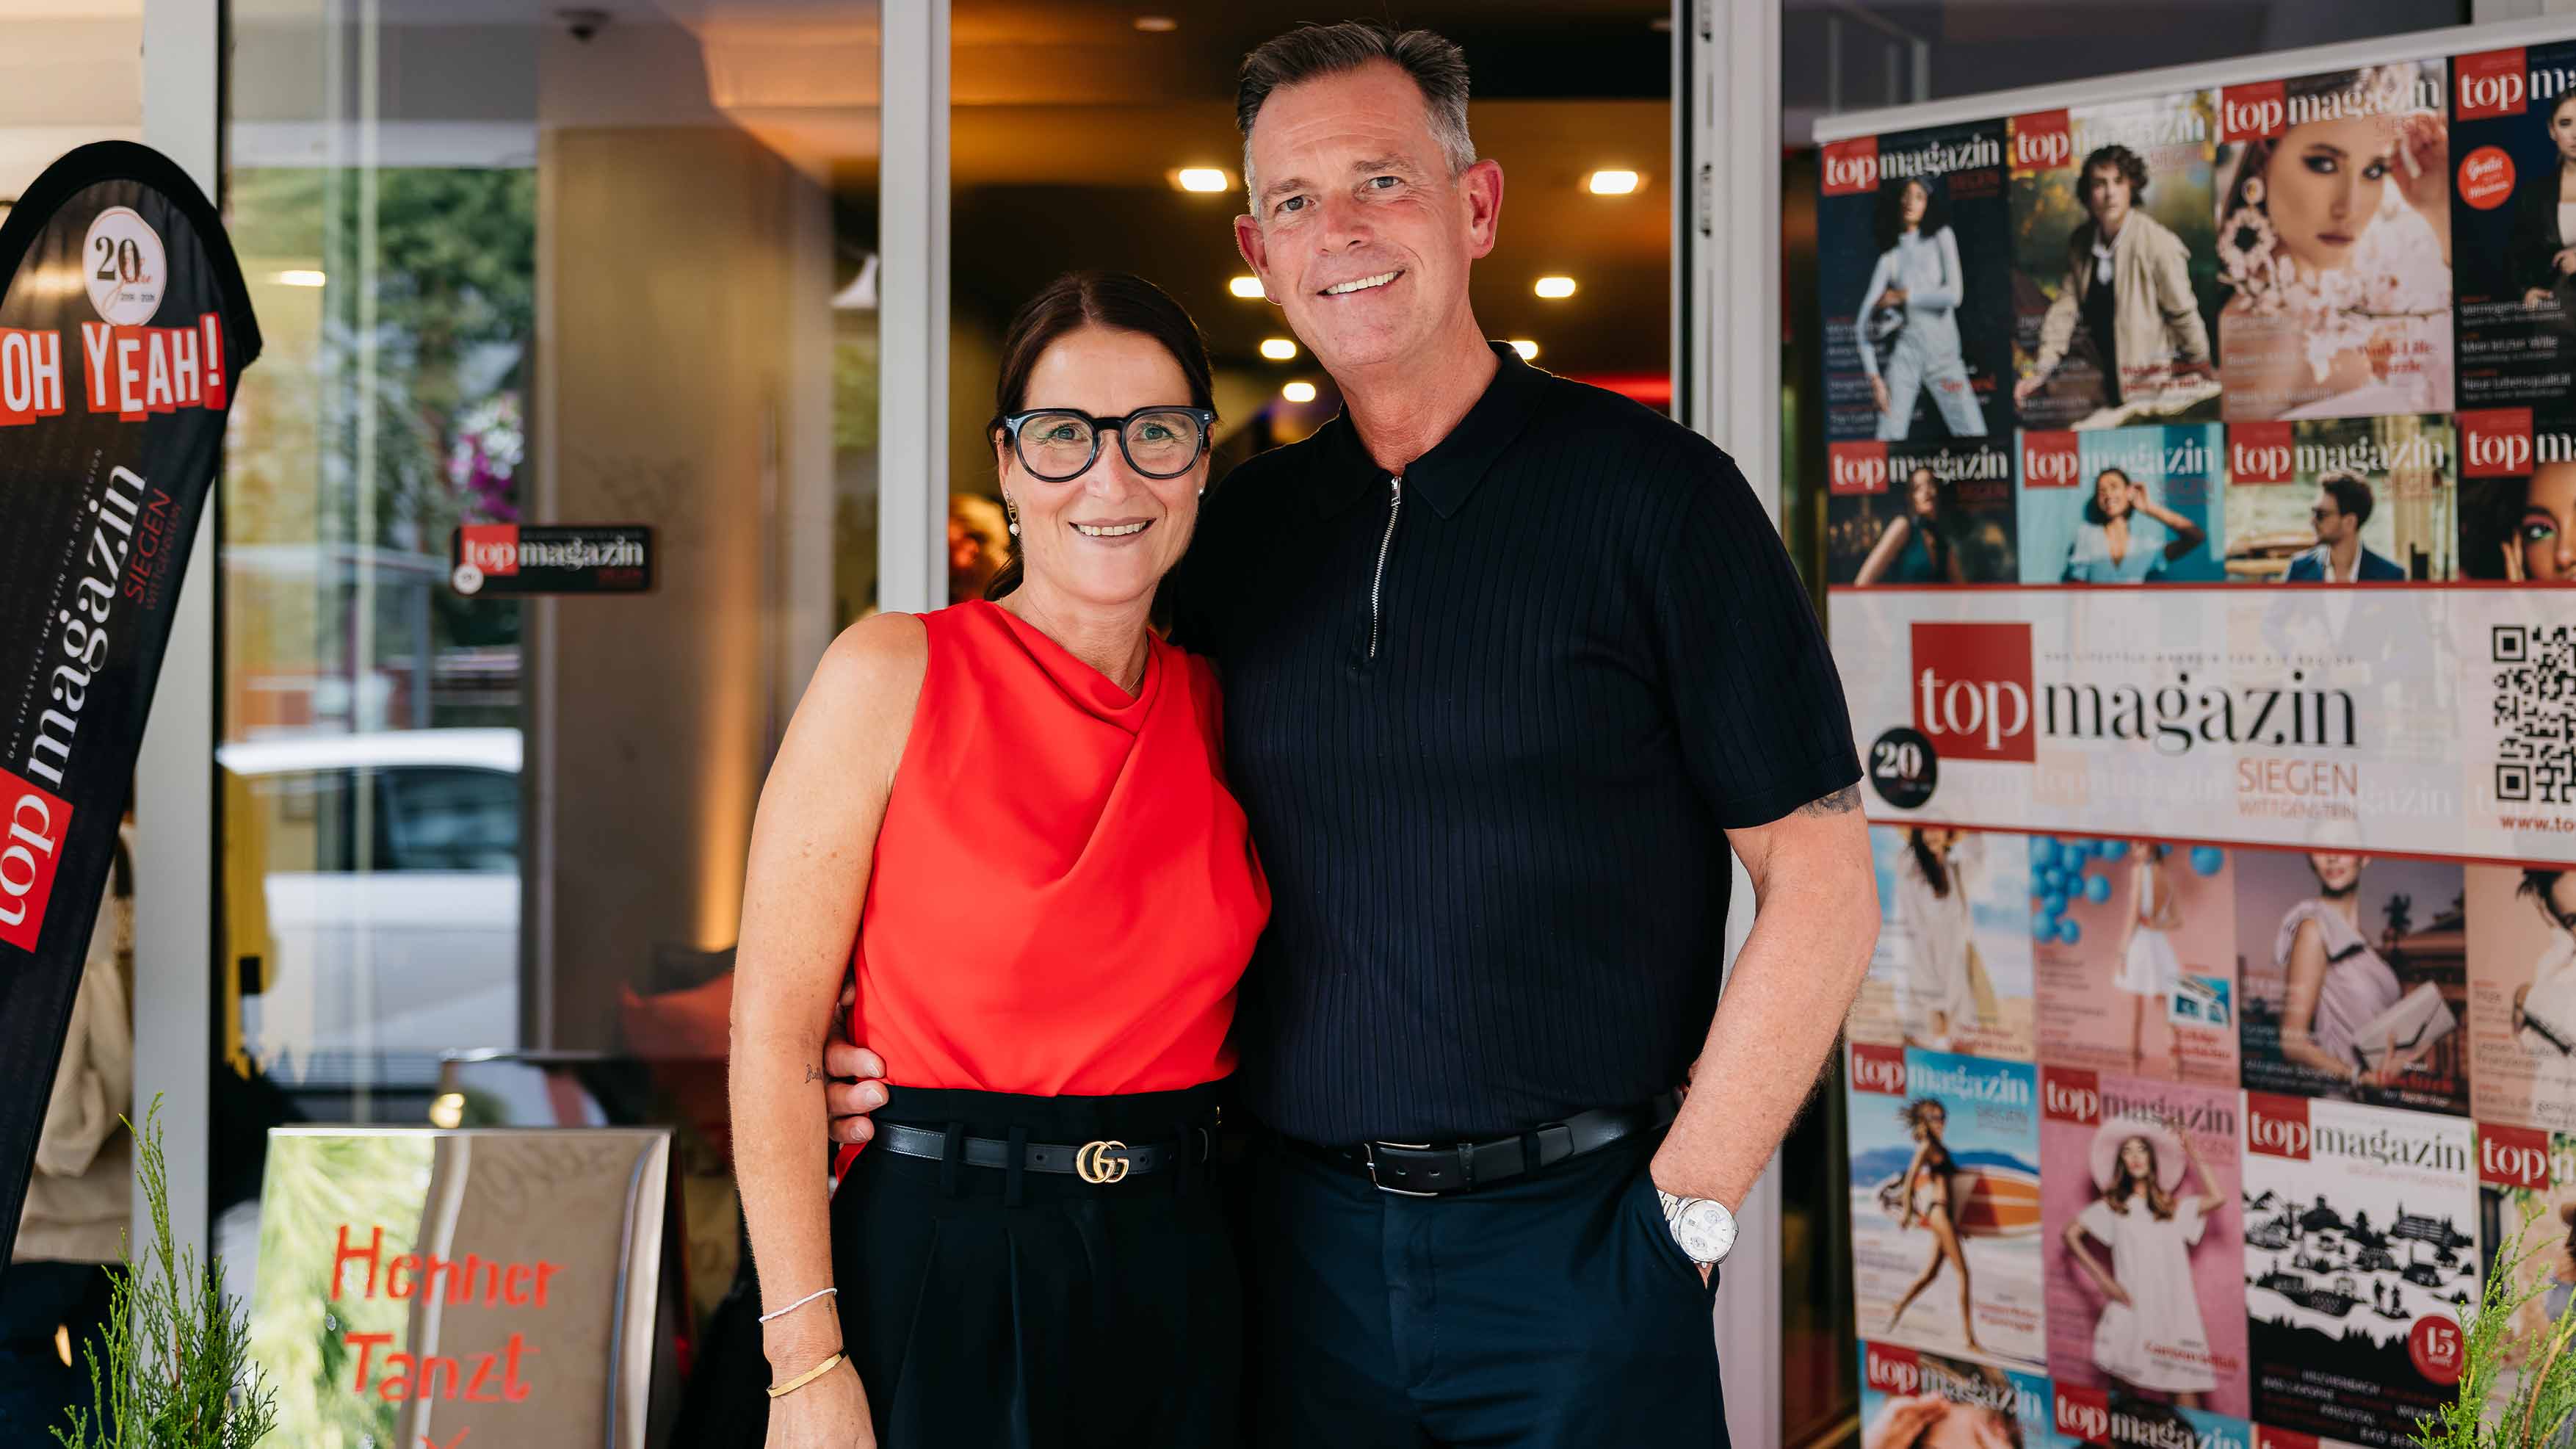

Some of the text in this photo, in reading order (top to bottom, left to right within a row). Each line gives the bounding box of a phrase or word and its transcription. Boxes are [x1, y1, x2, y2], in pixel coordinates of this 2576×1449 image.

[2461, 72, 2524, 112] top
[2226, 98, 2282, 135] top
[1826, 131, 2000, 189] top magazin
[2018, 131, 2069, 165] top
[95, 236, 142, 283] 20
[1, 314, 221, 412] OH YEAH!
[1834, 454, 1886, 490] top
[2026, 448, 2078, 485] top
[2234, 433, 2445, 480] top magazin
[2468, 430, 2530, 471] top
[124, 488, 171, 604] SIEGEN
[466, 535, 644, 571] top magazin
[0, 465, 147, 926] top magazin
[1919, 667, 2362, 756] top magazin
[1875, 741, 1923, 778] 20
[2237, 757, 2359, 797] SIEGEN
[2238, 798, 2359, 822] WITTGENSTEIN
[1855, 1052, 2030, 1106] top magazin
[2046, 1080, 2235, 1136] top magazin
[2250, 1109, 2467, 1173] top magazin
[2483, 1136, 2547, 1185] top
[330, 1224, 568, 1308] Henner
[2427, 1326, 2456, 1358] 15
[344, 1331, 542, 1403] Tanzt
[1868, 1351, 1918, 1394] top
[2056, 1394, 2108, 1439] top
